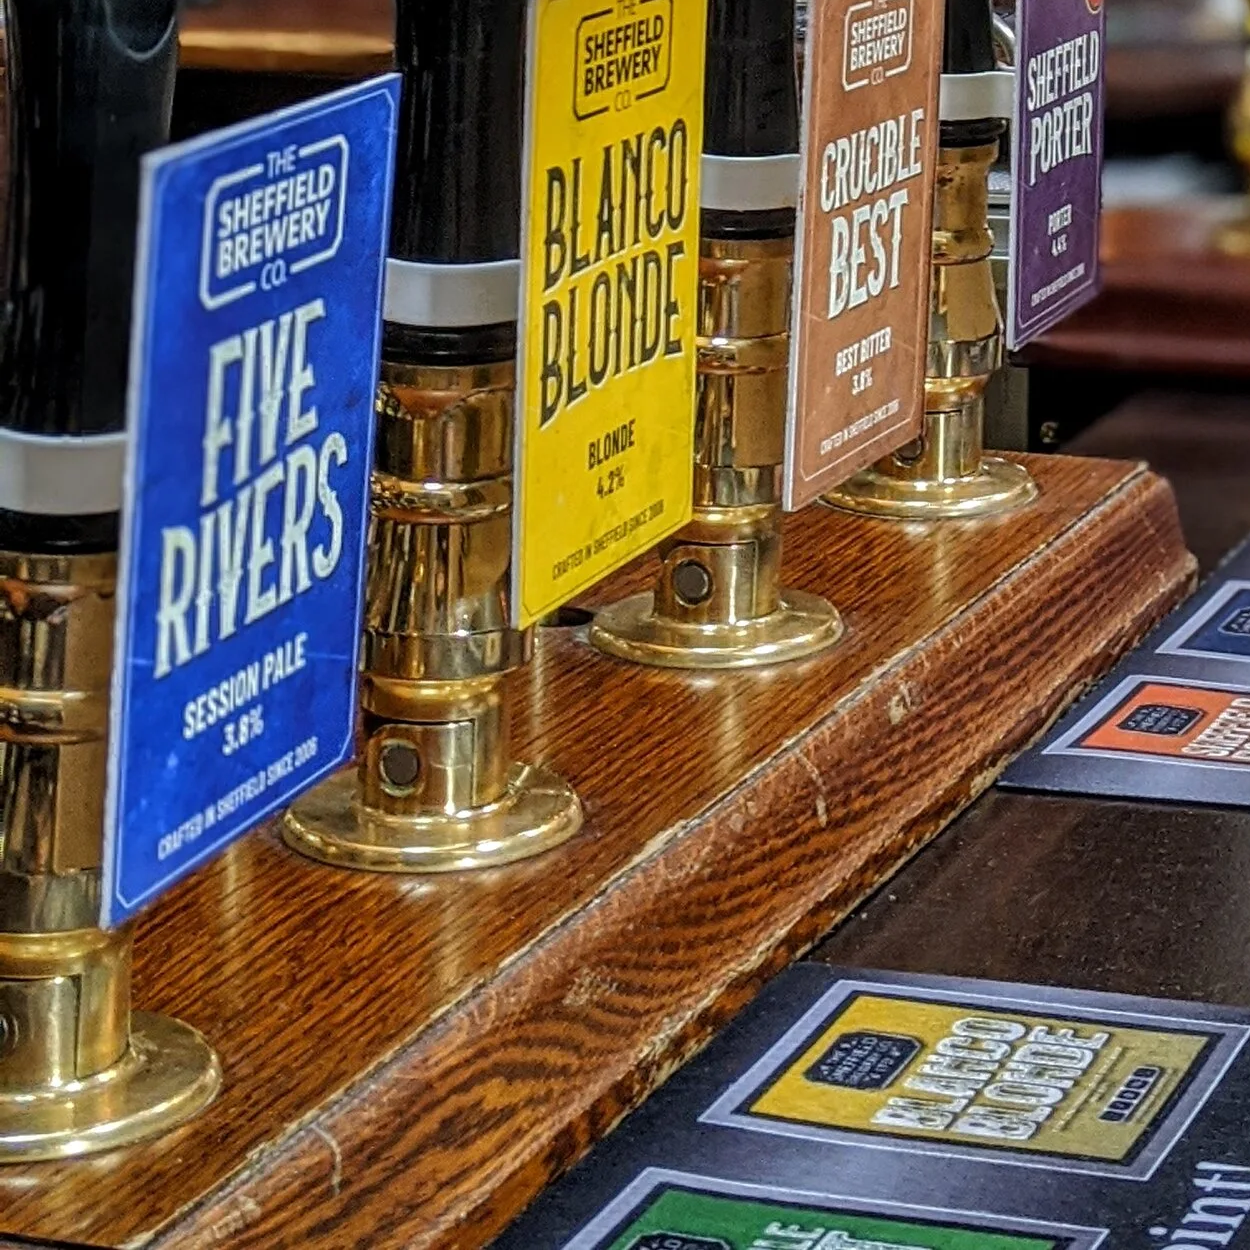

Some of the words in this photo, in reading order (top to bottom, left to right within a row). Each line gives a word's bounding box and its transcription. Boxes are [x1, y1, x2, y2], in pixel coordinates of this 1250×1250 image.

[583, 13, 664, 65] SHEFFIELD
[849, 31, 906, 71] BREWERY
[850, 7, 907, 46] SHEFFIELD
[583, 43, 662, 97] BREWERY
[1027, 30, 1100, 111] SHEFFIELD
[266, 144, 297, 180] THE
[820, 108, 924, 213] CRUCIBLE
[1029, 91, 1094, 187] PORTER
[216, 199, 331, 280] BREWERY
[218, 162, 337, 239] SHEFFIELD
[543, 117, 688, 293] BLANCO
[827, 188, 909, 320] BEST
[539, 241, 685, 429] BLONDE
[835, 343, 860, 377] BEST
[860, 326, 892, 363] BITTER
[200, 297, 326, 507] FIVE
[588, 418, 636, 470] BLONDE
[596, 465, 626, 499] 4.2%
[153, 432, 349, 679] RIVERS
[182, 668, 259, 740] SESSION
[262, 631, 309, 692] PALE
[222, 704, 265, 756] 3.8%
[158, 813, 204, 861] CRAFTED
[204, 803, 217, 829] IN
[217, 770, 266, 821] SHEFFIELD
[267, 750, 294, 786] SINCE
[870, 1014, 1027, 1131] BLANCO
[951, 1024, 1111, 1141] BLONDE
